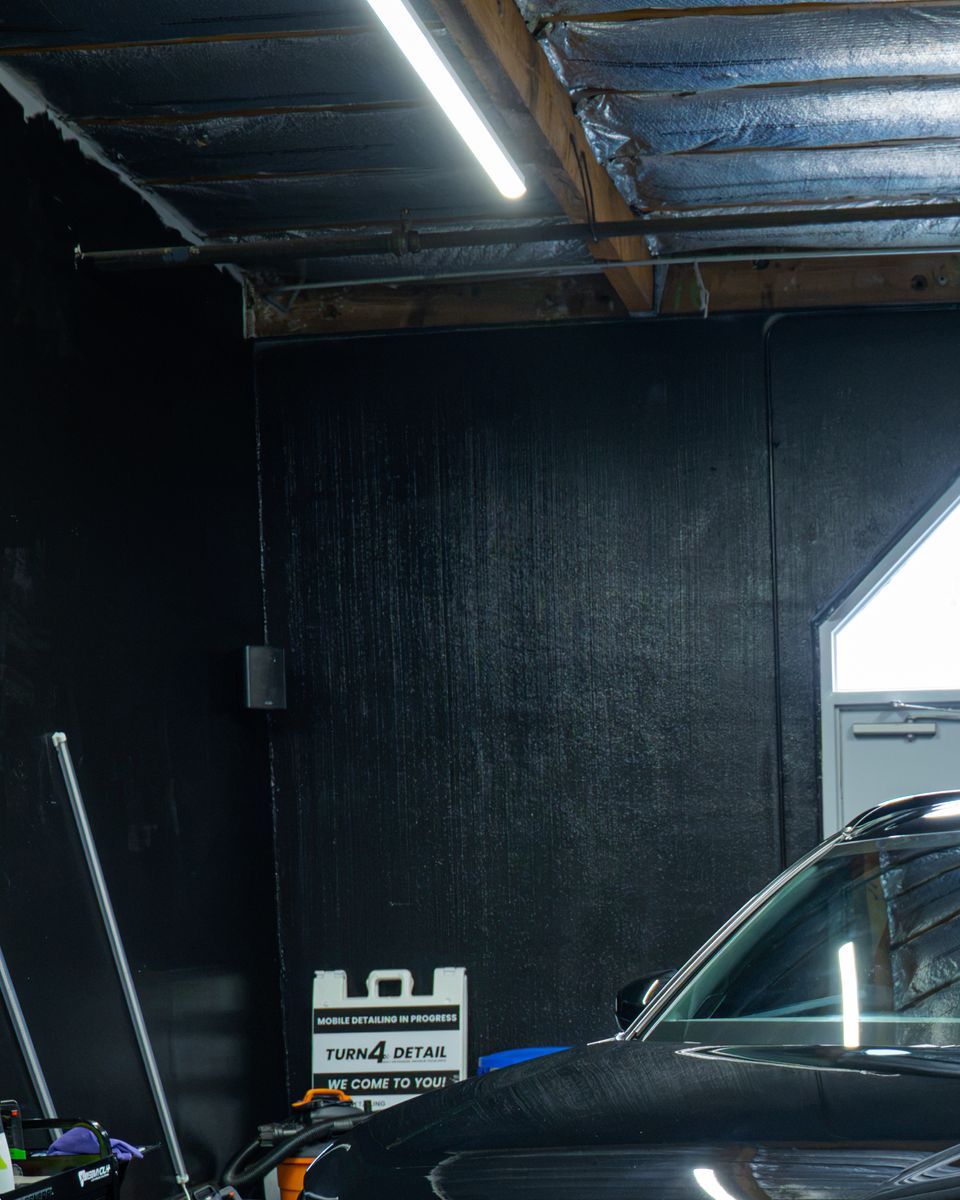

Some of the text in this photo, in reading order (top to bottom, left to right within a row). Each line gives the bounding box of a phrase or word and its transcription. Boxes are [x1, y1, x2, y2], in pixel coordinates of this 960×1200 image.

[317, 1014, 457, 1025] MOBILE DETAILING IN PROGRESS
[393, 1046, 447, 1059] DETAIL
[328, 1076, 447, 1090] WE COME TO YOU!
